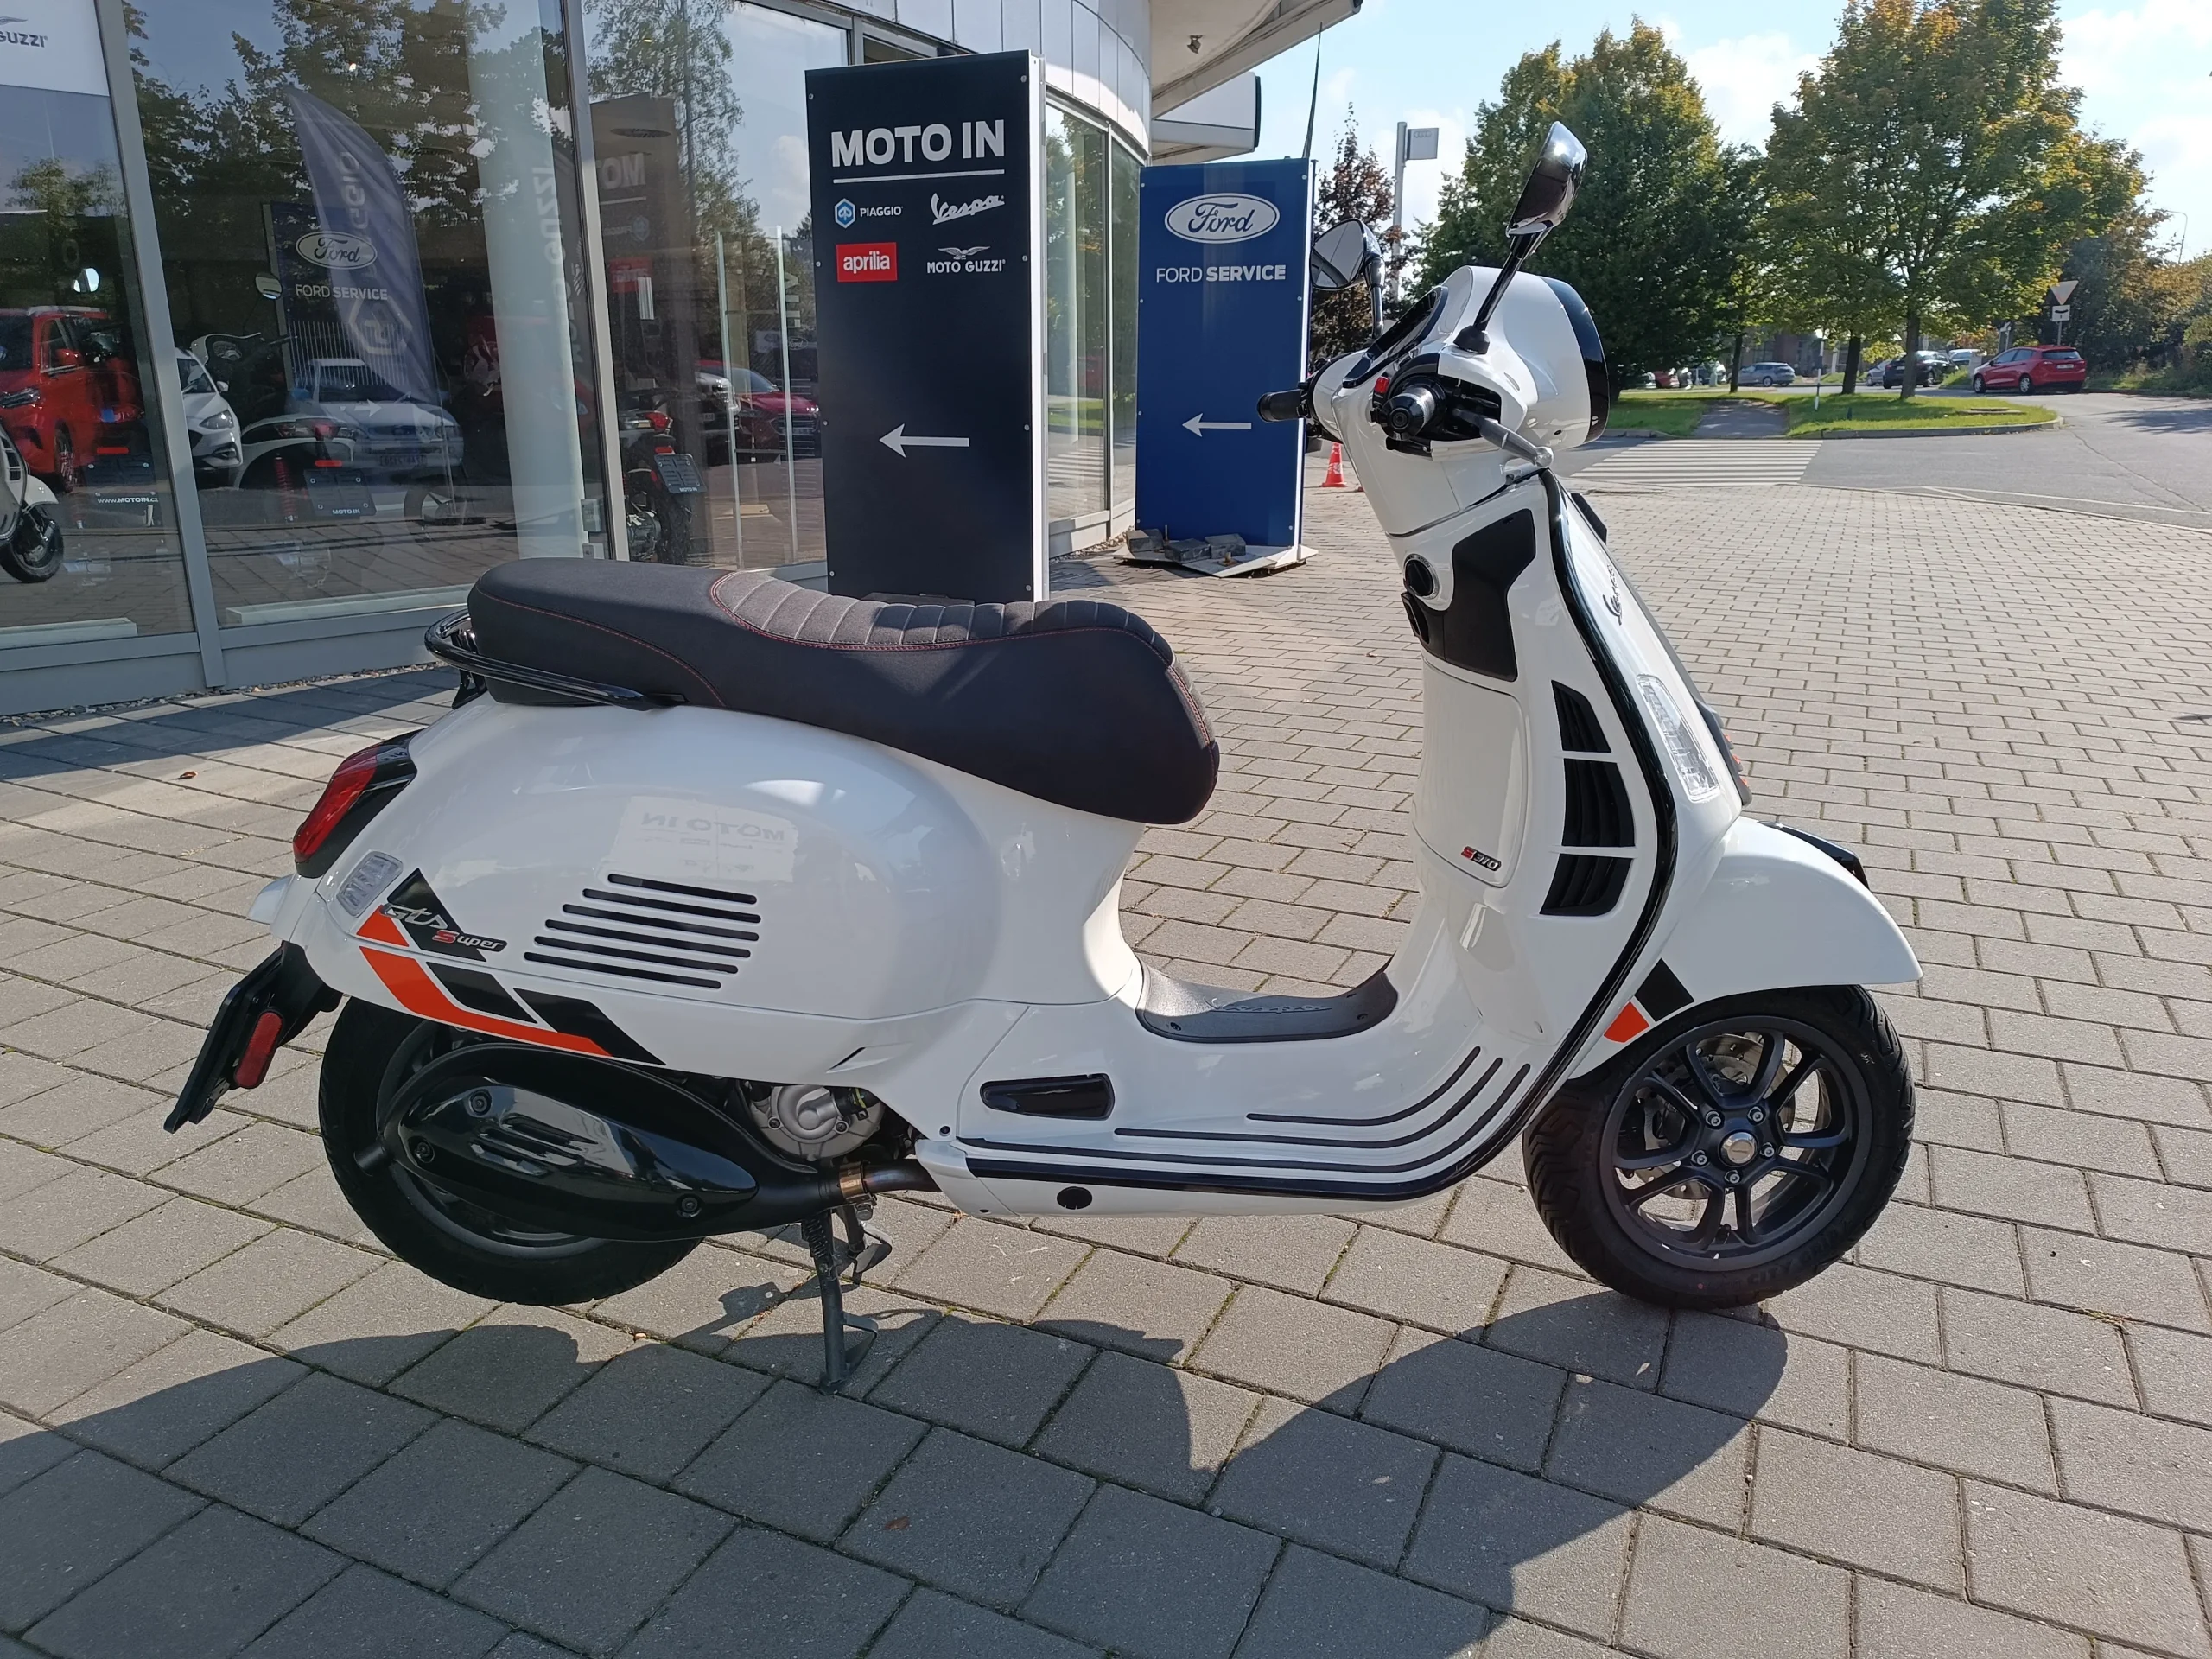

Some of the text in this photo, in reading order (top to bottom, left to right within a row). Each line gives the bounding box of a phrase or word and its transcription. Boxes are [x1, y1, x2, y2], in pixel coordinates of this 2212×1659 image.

[831, 119, 1005, 167] MOTO IN
[860, 206, 901, 217] PIAGGIO
[931, 193, 1005, 225] Vespa
[1187, 201, 1255, 233] Ford
[314, 237, 361, 263] Ford
[843, 251, 891, 274] aprilia
[927, 260, 1003, 274] MOTO GUZZI
[1156, 264, 1287, 283] FORD SERVICE
[296, 283, 388, 301] FORD SERVICE
[432, 929, 505, 950] Super
